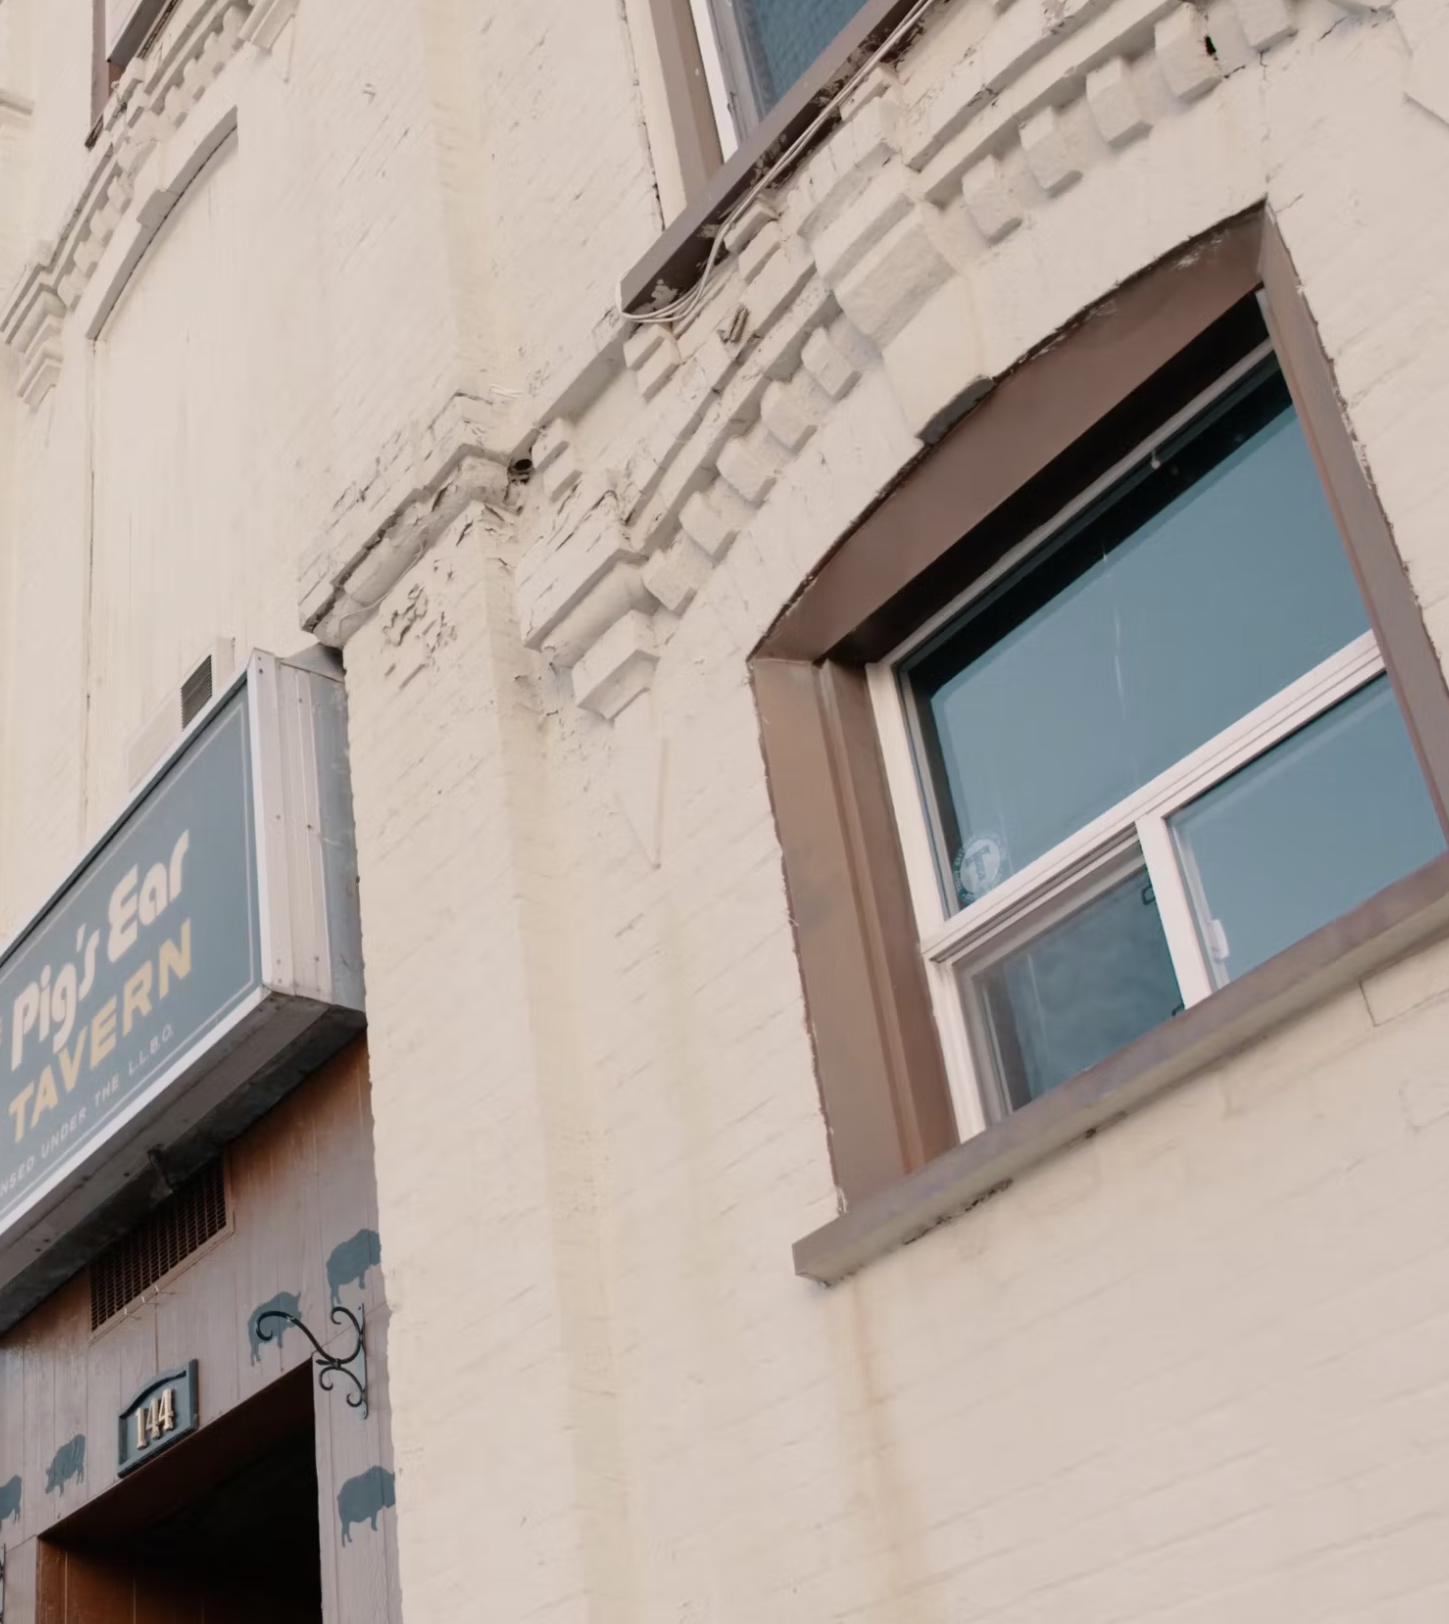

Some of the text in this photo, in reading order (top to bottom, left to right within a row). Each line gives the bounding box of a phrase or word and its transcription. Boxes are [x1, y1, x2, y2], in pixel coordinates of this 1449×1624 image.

[11, 922, 100, 1071] Pig's
[108, 829, 189, 963] Ear
[9, 918, 191, 1142] TAVERN
[41, 1106, 87, 1158] UNDER
[94, 1073, 120, 1107] THE
[135, 1388, 174, 1448] 144
